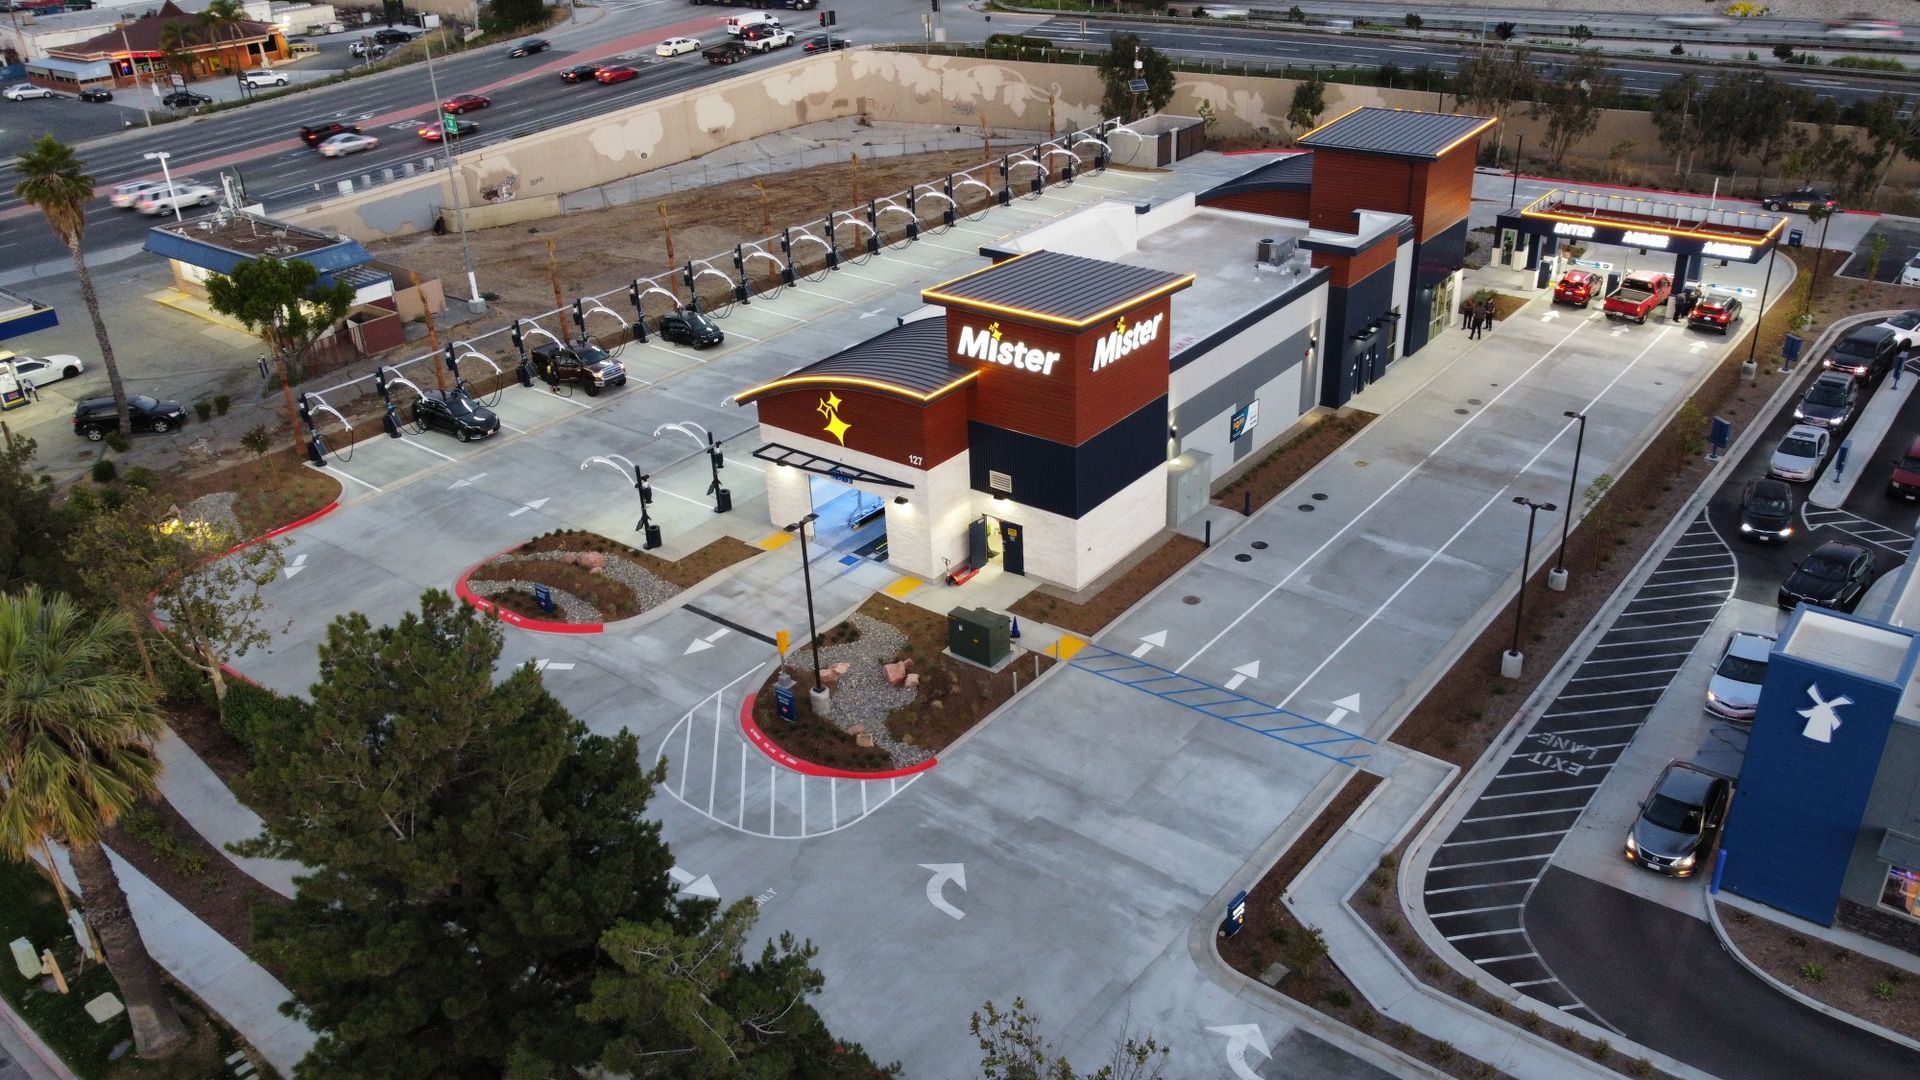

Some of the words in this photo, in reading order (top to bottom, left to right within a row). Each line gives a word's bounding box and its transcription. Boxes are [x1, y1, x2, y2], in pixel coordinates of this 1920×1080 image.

[1554, 222, 1595, 237] ENTER
[957, 325, 1060, 375] Mister
[1091, 312, 1164, 373] Mister
[908, 454, 923, 466] 127
[1537, 732, 1599, 760] LANE
[1527, 751, 1585, 777] EXIT
[755, 887, 778, 907] NLY
